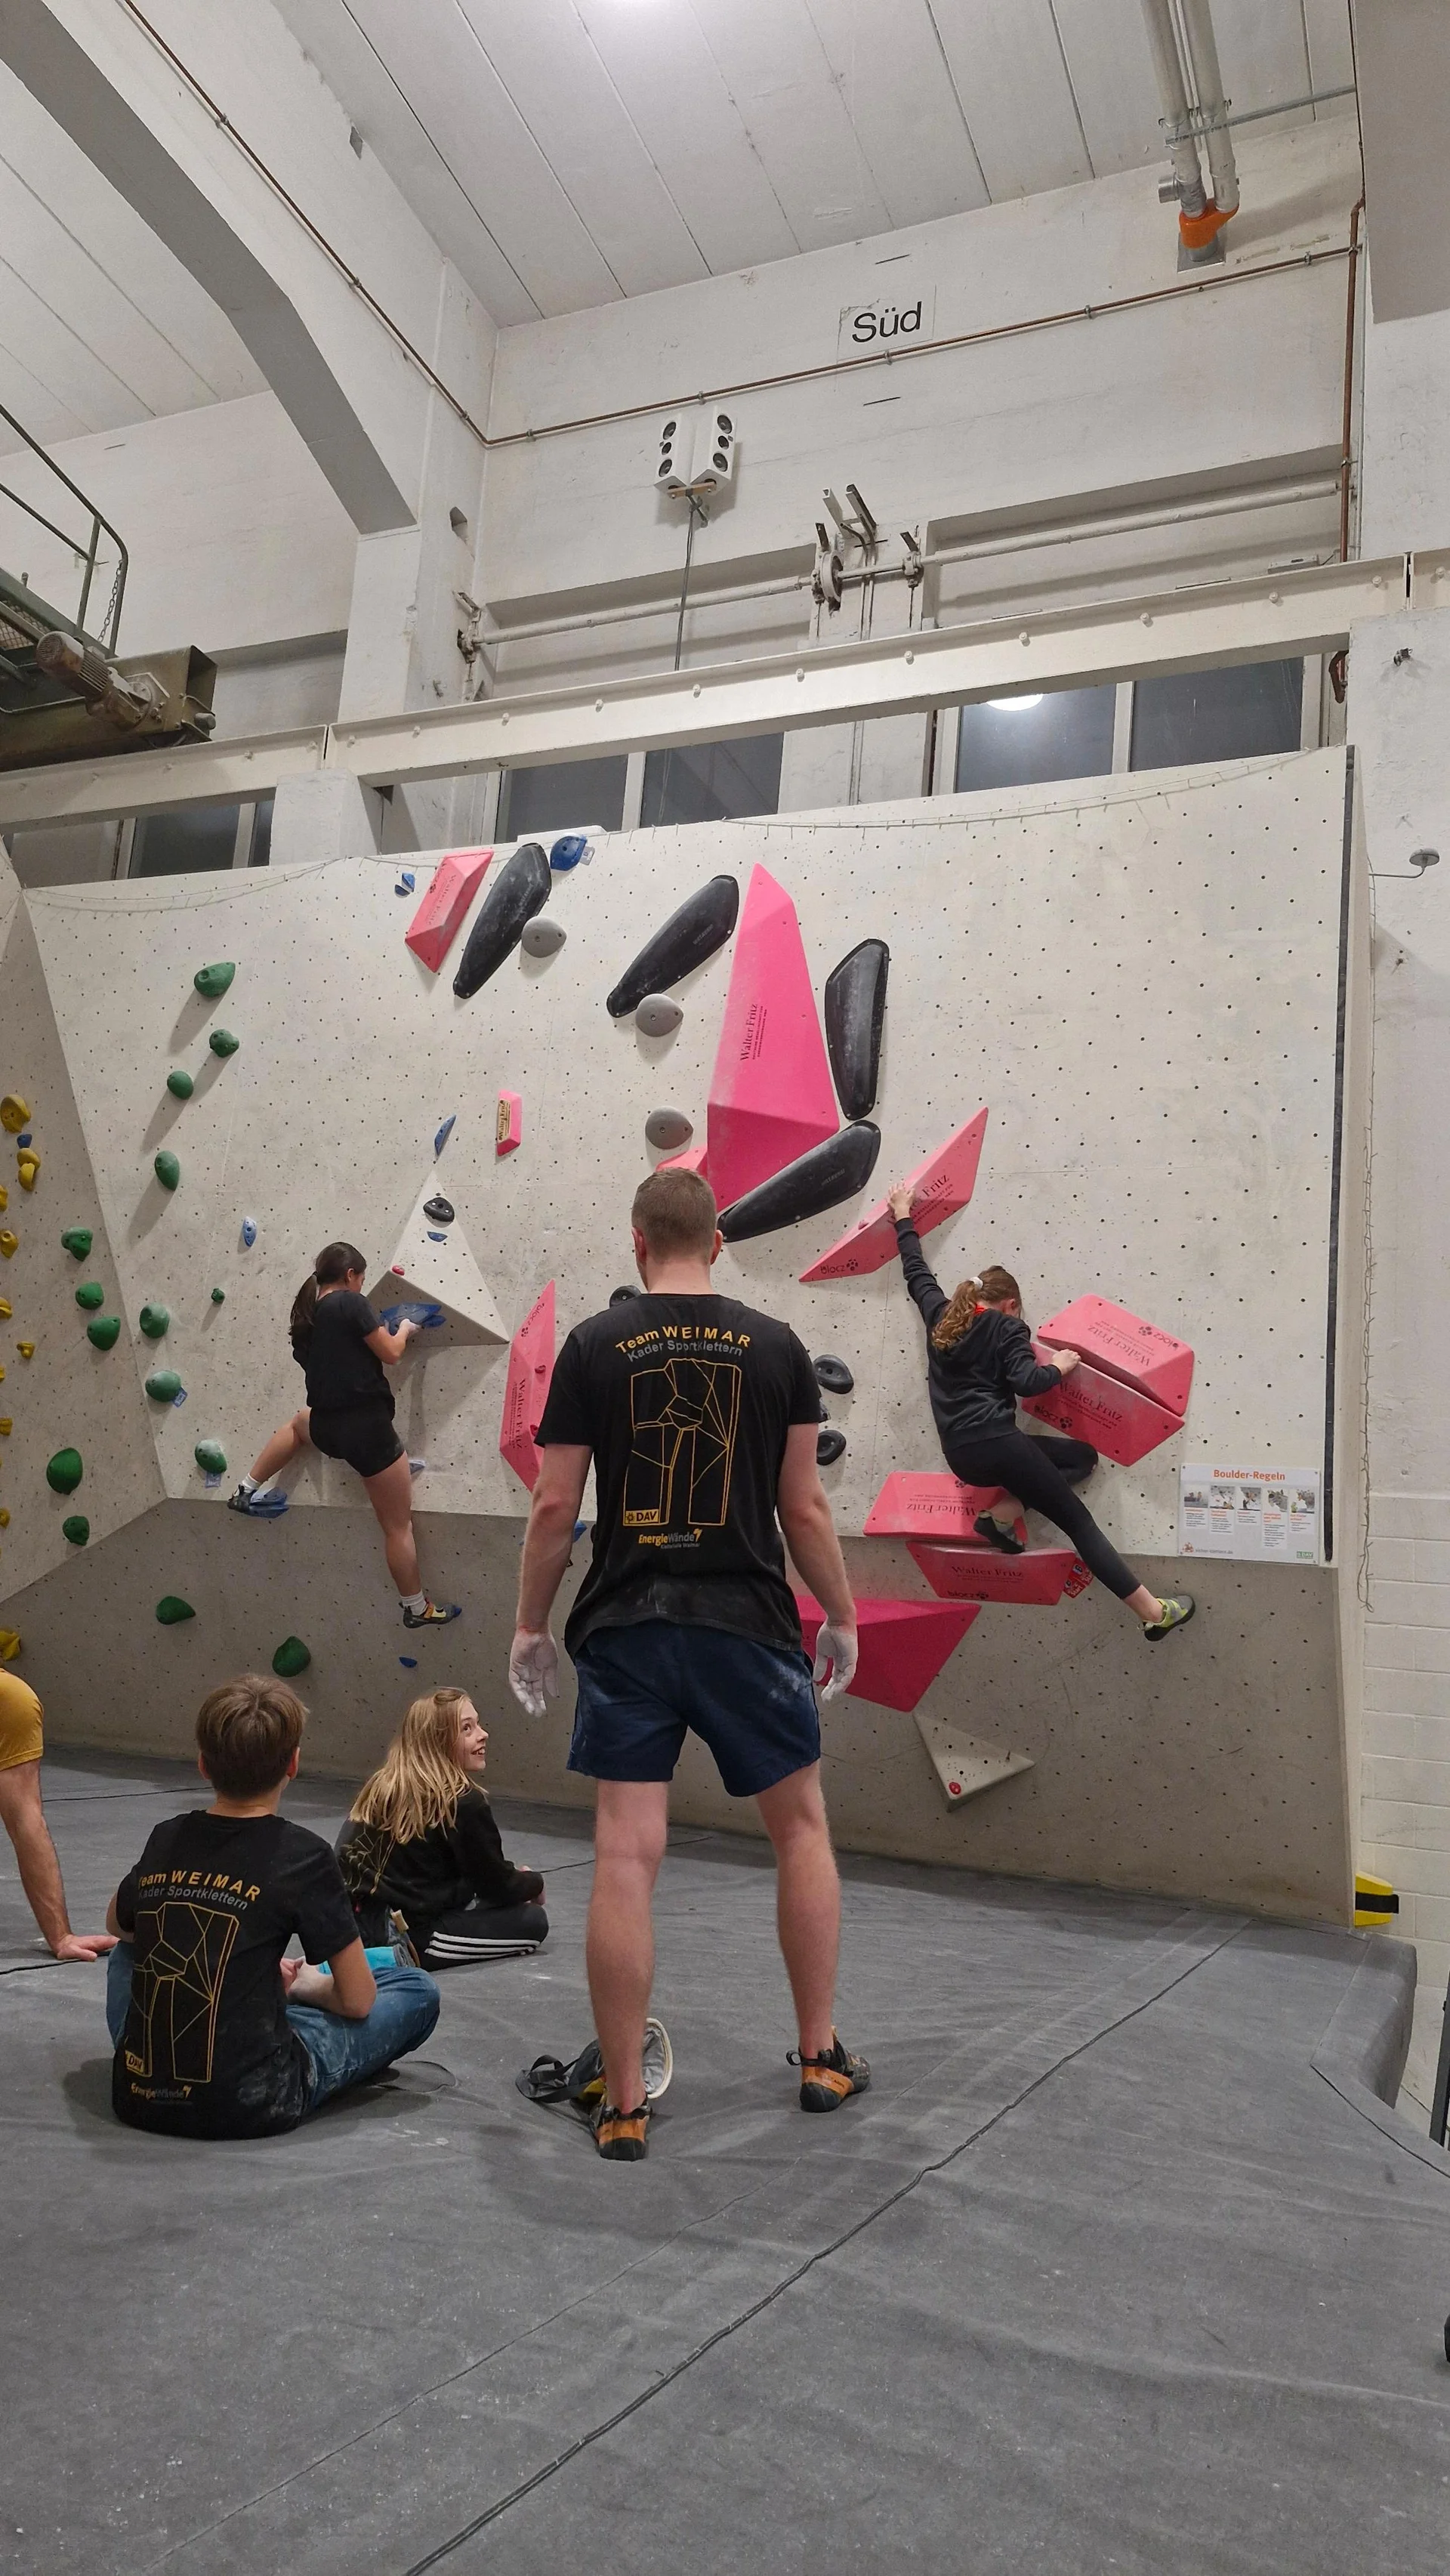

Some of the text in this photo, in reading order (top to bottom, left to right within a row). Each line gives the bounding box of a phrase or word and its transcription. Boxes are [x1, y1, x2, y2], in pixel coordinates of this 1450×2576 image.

[852, 301, 923, 343] Süd
[739, 1004, 757, 1061] Walter Fritz
[922, 1175, 950, 1197] Fritz
[615, 1325, 751, 1354] Team WEIMAR
[1087, 1324, 1114, 1345] Fritz
[627, 1339, 743, 1363] Kader Sportklettern
[1115, 1338, 1151, 1367] Walter
[1058, 1380, 1094, 1407] Walter
[1095, 1395, 1124, 1423] Fritz
[514, 1378, 526, 1450] Walter Fritz
[1213, 1469, 1285, 1482] Boulder-Regeln
[635, 1511, 658, 1522] DAV
[906, 1503, 979, 1517] Walter Fritz
[638, 1531, 695, 1546] EnergieWände
[950, 1565, 1024, 1578] Walter Fritz
[138, 1885, 248, 1911] Kader Sportklettern
[171, 1870, 261, 1902] WEIMAR
[128, 2055, 143, 2071] DAV
